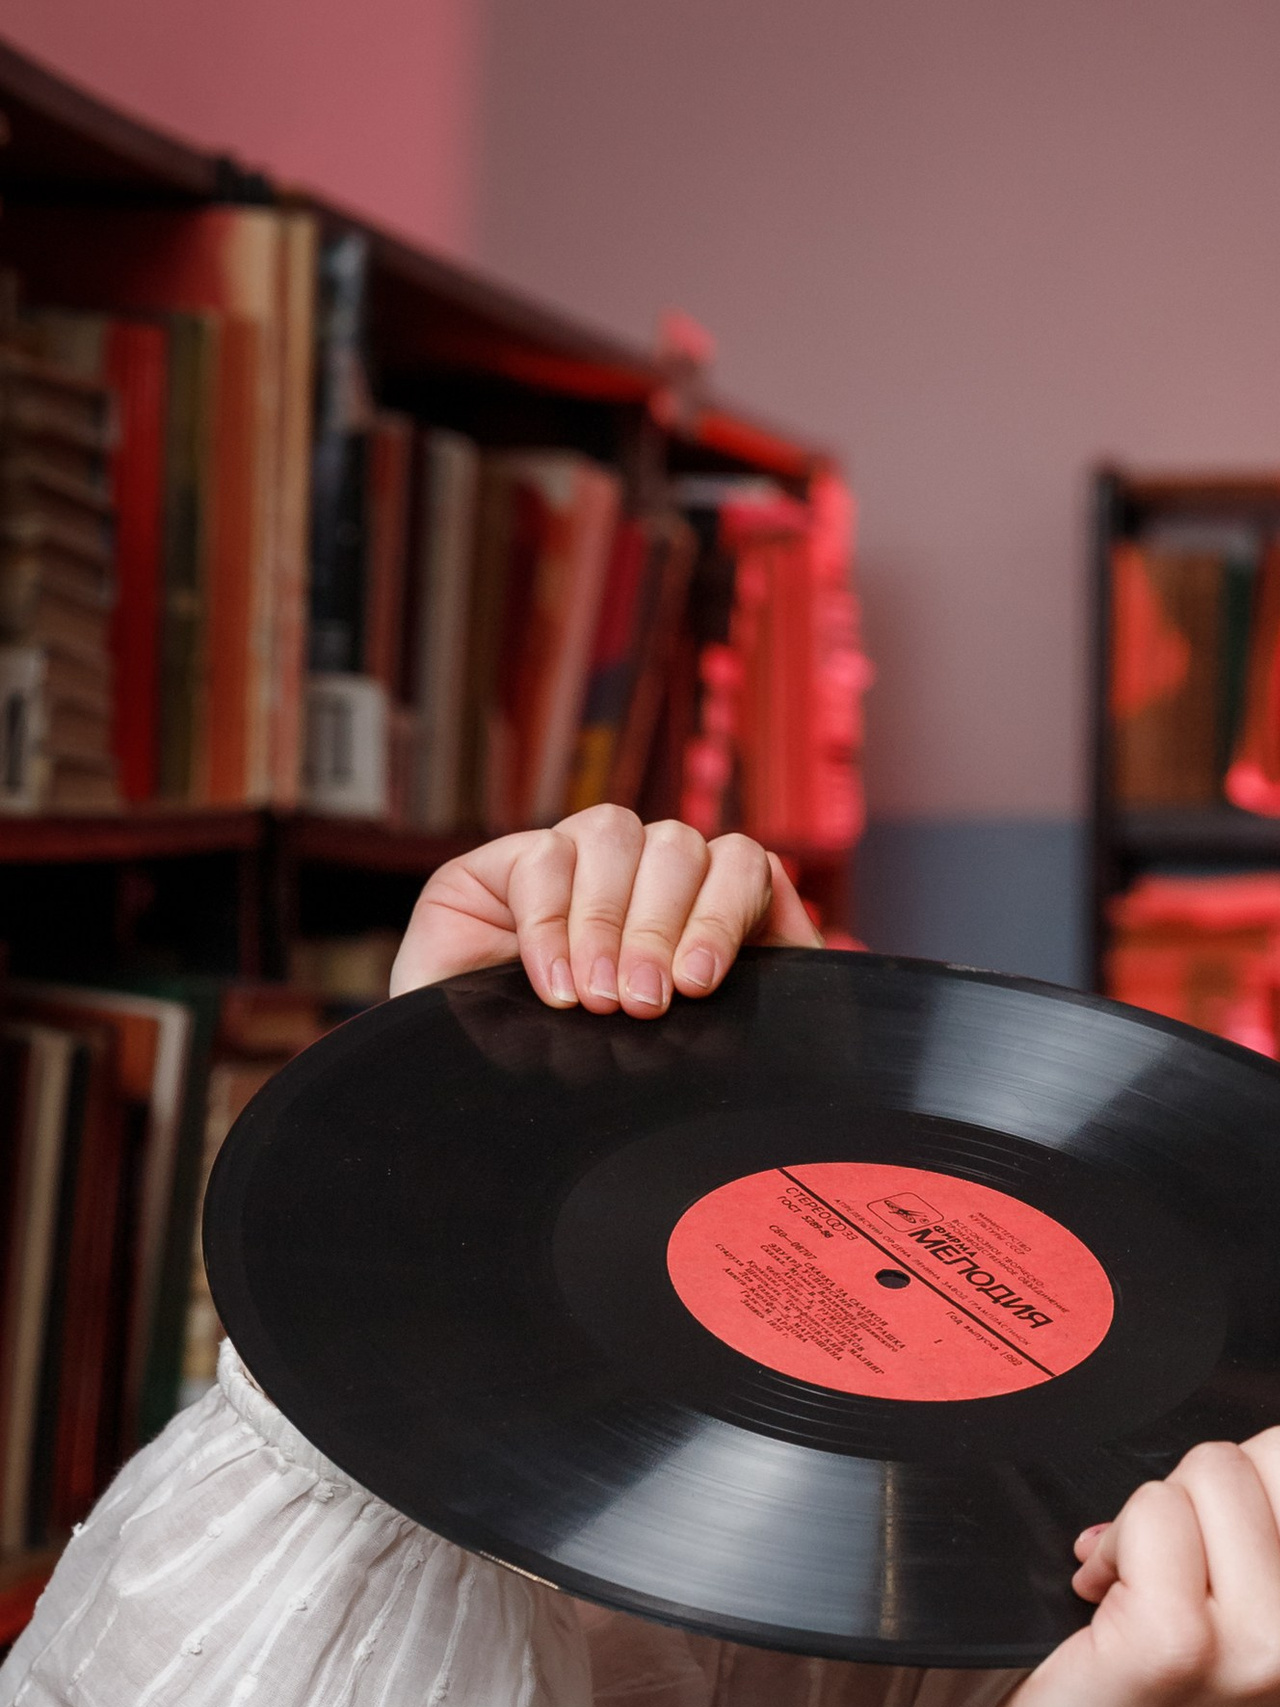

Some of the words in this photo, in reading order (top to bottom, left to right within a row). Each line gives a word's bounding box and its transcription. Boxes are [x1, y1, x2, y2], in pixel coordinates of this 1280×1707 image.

[777, 1196, 802, 1213] ГОСТ
[786, 1187, 832, 1219] СТЕРЕО
[933, 1226, 977, 1258] ФИРМА
[952, 1219, 1003, 1255] ВСЕСОЮЗНОЕ
[715, 1244, 744, 1266] Старуха
[945, 1222, 1018, 1275] ПРОИЗВОДСТВЕННОЕ
[1018, 1276, 1070, 1313] ОБЪЕДИНЕНИЕ
[767, 1243, 802, 1269] ЭДУАРД
[857, 1311, 906, 1349] ЧЕБУРАШКА
[788, 1268, 816, 1289] Музыка
[814, 1291, 859, 1322] Владимира
[801, 1263, 835, 1287] СКАЗКА
[836, 1288, 848, 1297] ЗА
[883, 1236, 911, 1258] ОРДЕНА
[912, 1259, 940, 1280] ЛЕНИНА
[941, 1281, 968, 1300] ЗАВОД
[968, 1300, 1031, 1345] ГРАМПЛАСТИНОК
[908, 1228, 1053, 1329] МЕЛОДИЯ
[746, 1260, 780, 1287] Крокодил
[814, 1314, 865, 1351] САЛЬНИКОВ
[818, 1299, 860, 1330] ВОЛОДИН
[774, 1318, 808, 1343] АРДОВА
[817, 1308, 862, 1342] РУМЯНОВА
[946, 1311, 963, 1325] Год
[964, 1325, 999, 1351] выпуска
[1000, 1352, 1022, 1366] 1992
